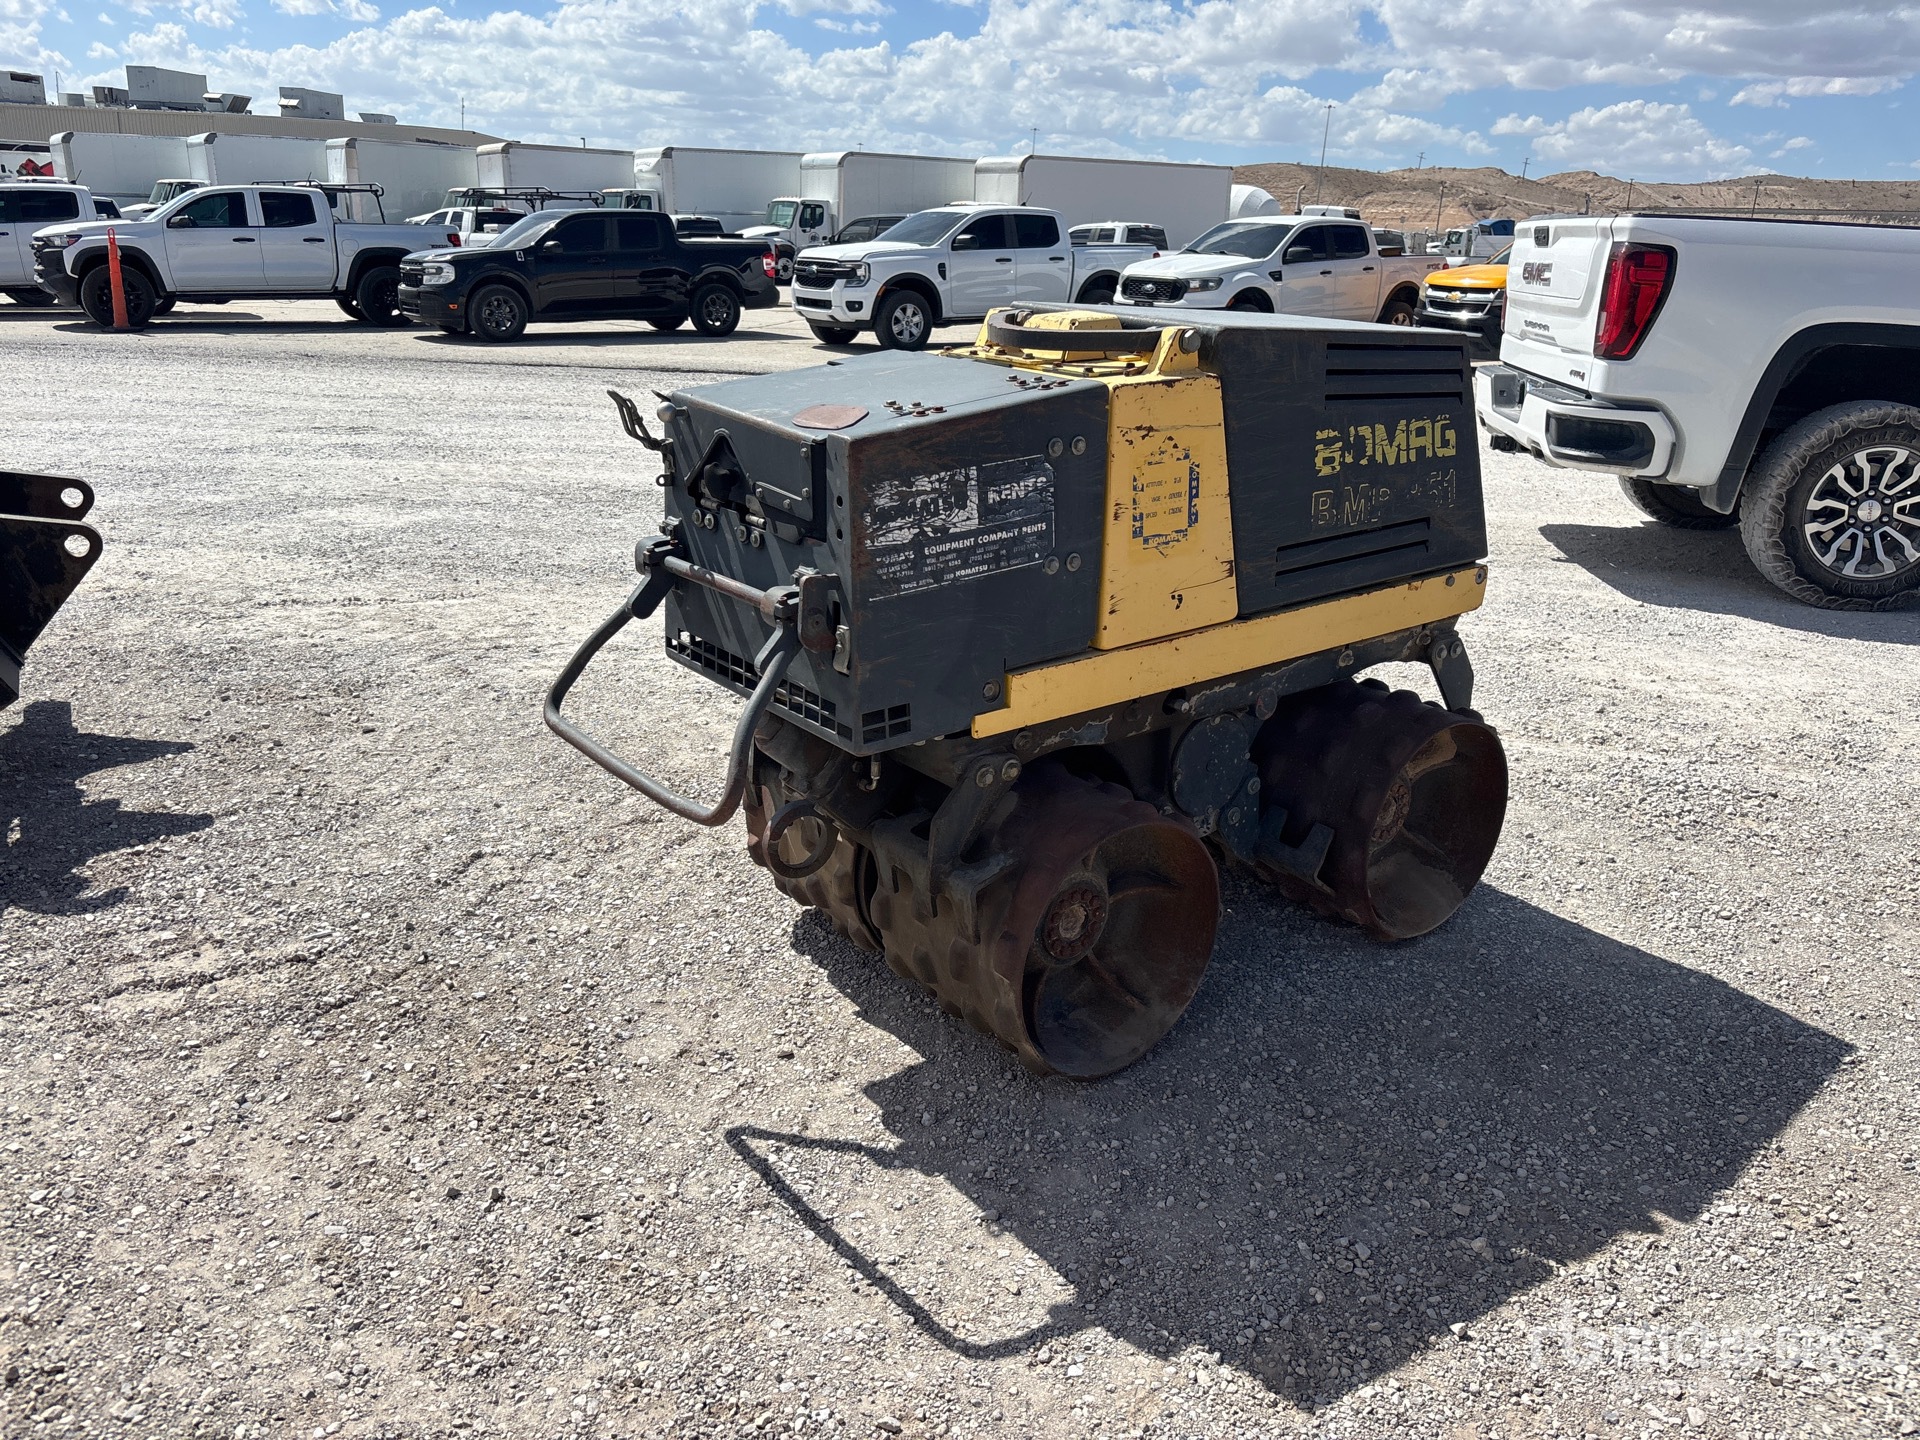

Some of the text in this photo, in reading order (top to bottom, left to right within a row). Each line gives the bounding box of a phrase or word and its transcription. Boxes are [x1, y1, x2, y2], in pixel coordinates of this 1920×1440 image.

[1522, 262, 1553, 287] GMC
[924, 538, 975, 555] EQUIPMENT
[978, 528, 1019, 544] COMPANY
[955, 564, 988, 577] KOMATSU
